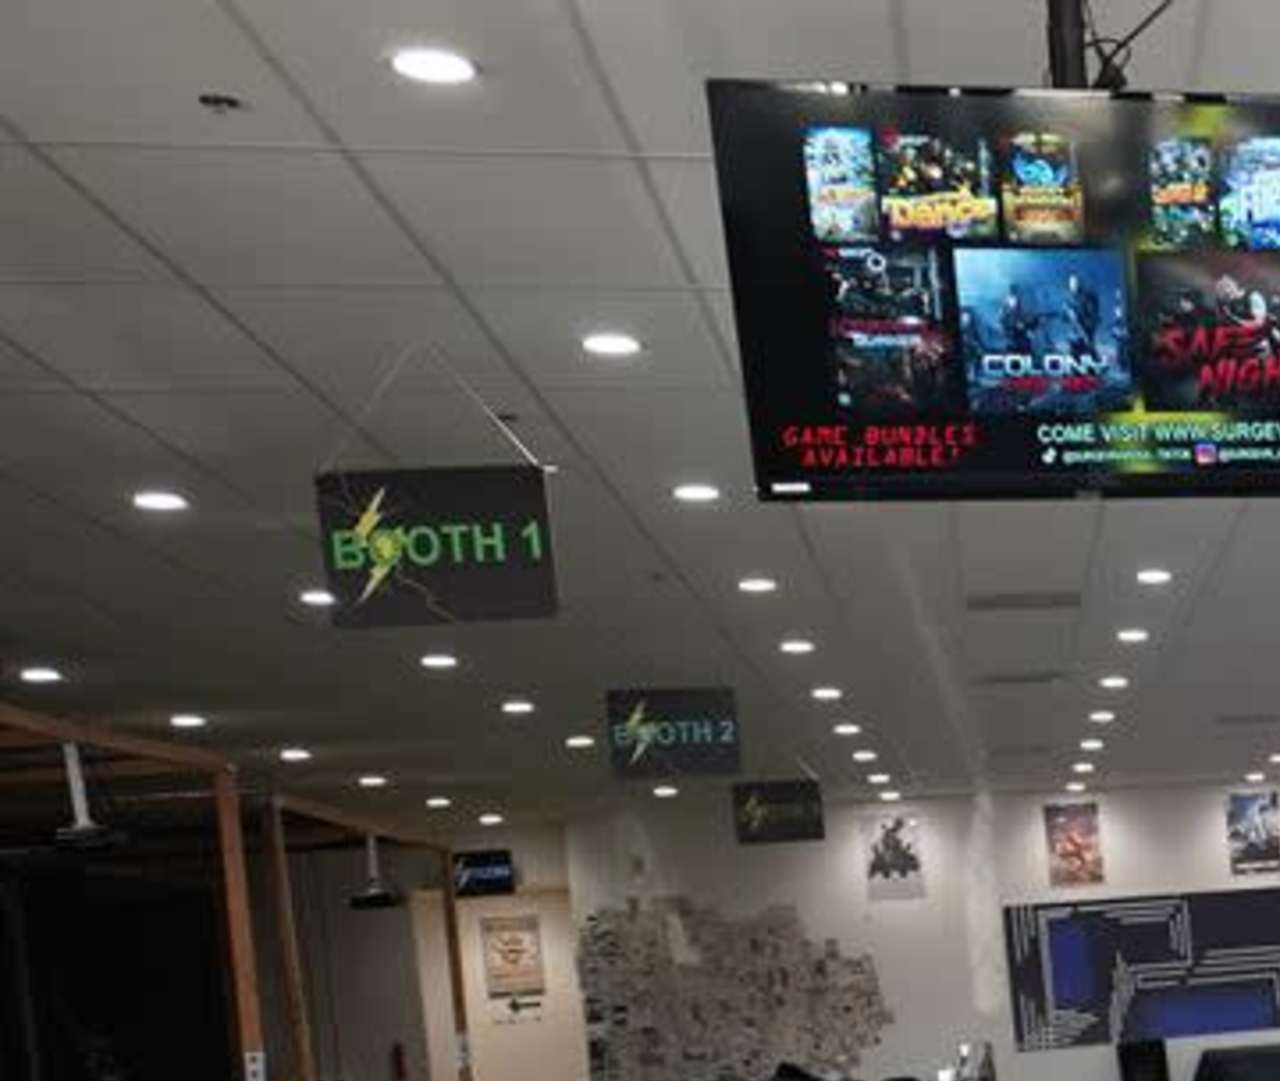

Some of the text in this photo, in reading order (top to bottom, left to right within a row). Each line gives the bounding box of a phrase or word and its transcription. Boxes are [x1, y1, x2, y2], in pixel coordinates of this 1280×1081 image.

[983, 354, 1107, 376] COLONY
[781, 423, 977, 447] GAME BUNDLES
[1037, 423, 1096, 443] COME
[1100, 423, 1149, 442] VISIT
[332, 519, 543, 570] BOOTH 1
[720, 721, 735, 742] 2
